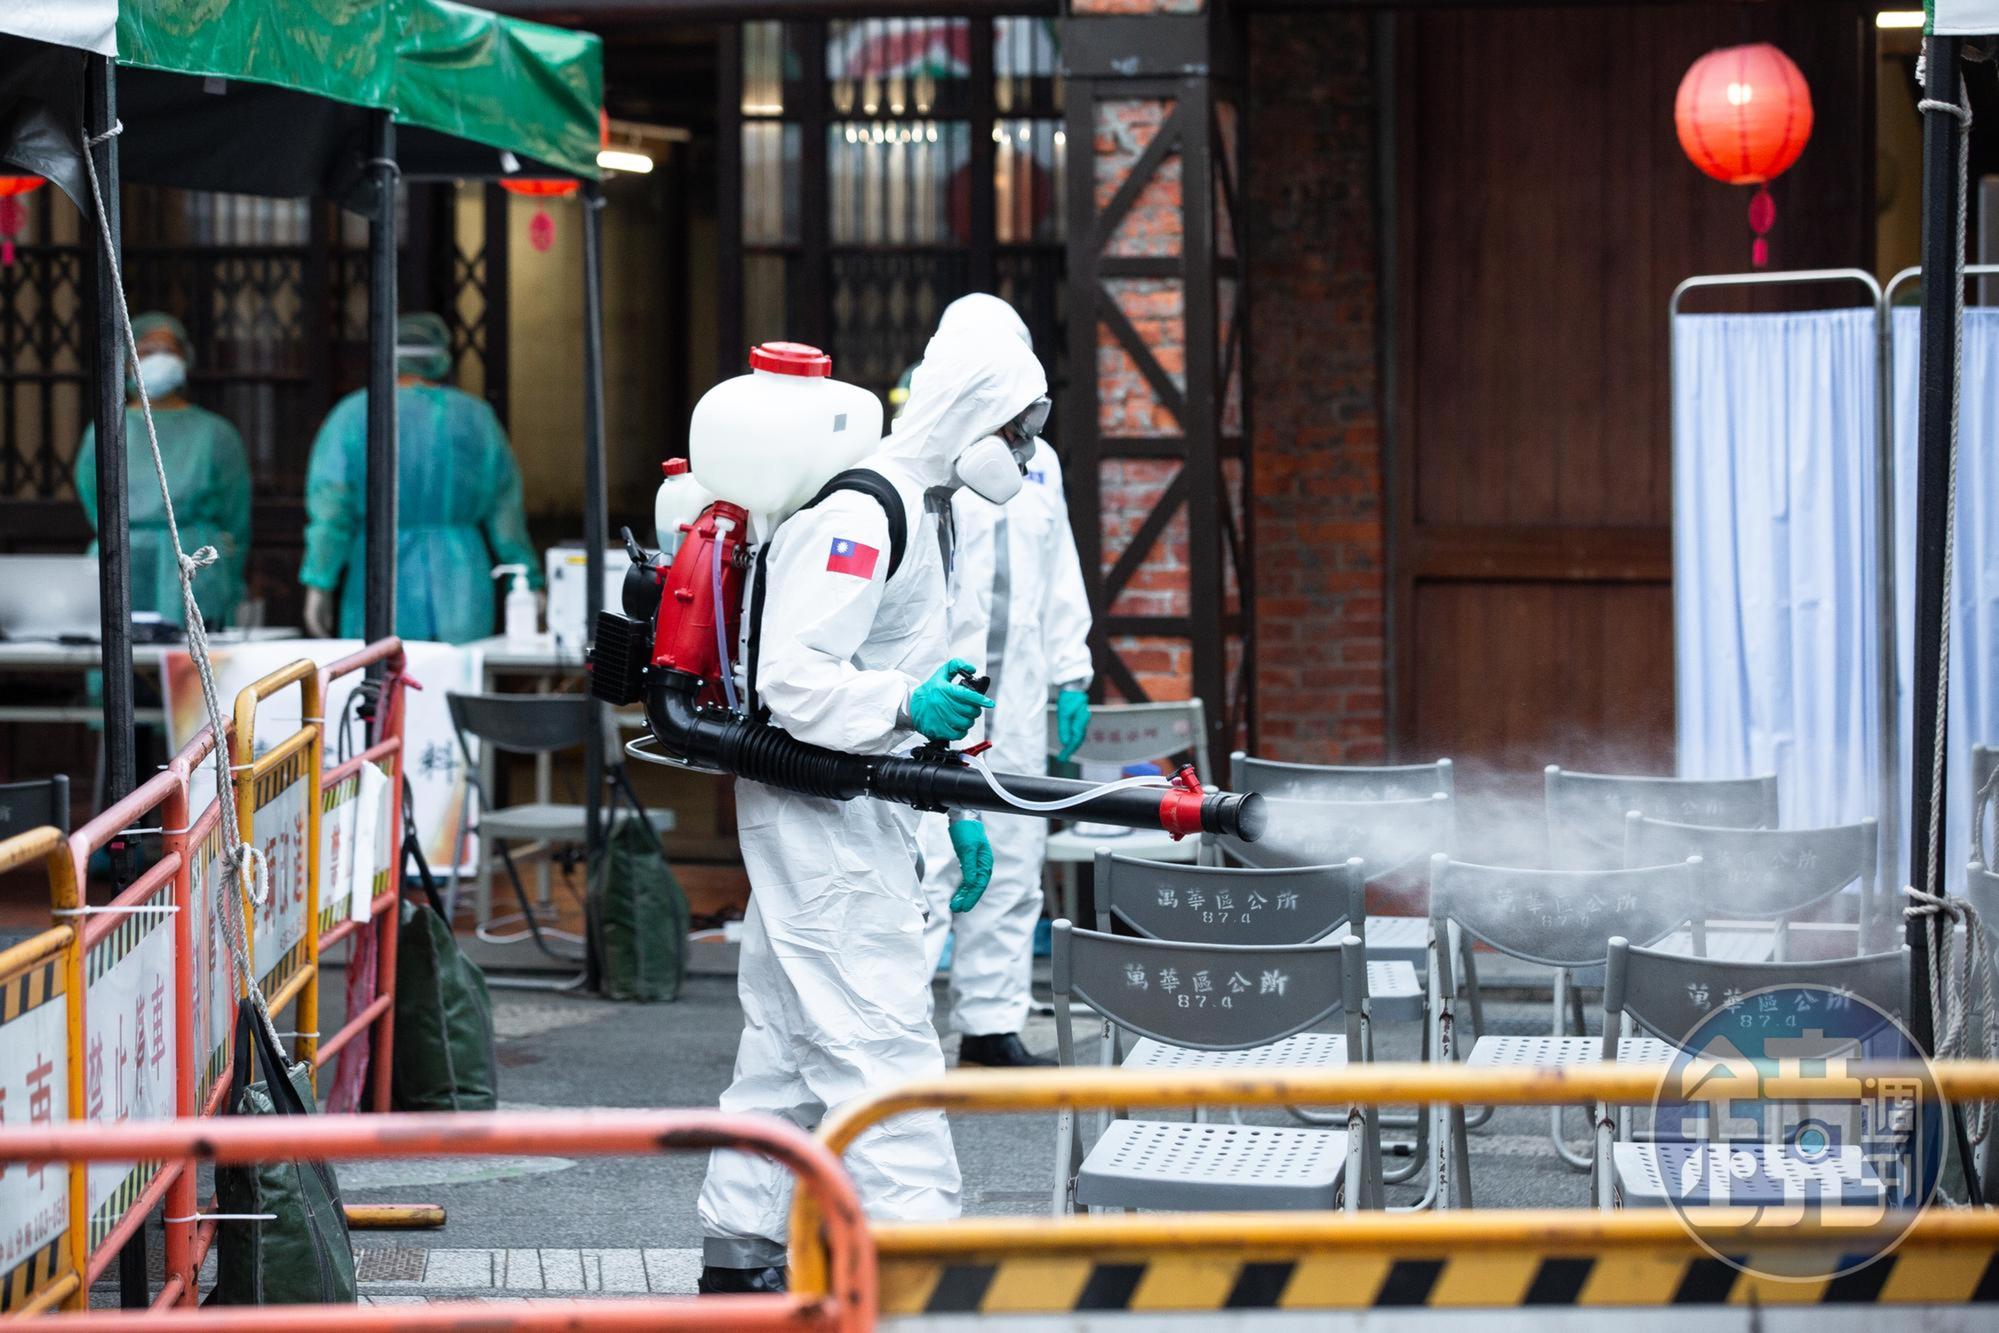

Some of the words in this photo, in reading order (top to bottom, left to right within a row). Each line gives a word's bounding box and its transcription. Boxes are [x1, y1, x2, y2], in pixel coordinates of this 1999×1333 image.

[1124, 963, 1288, 997] 萬華區公所
[1686, 982, 1856, 1016] 萬華區公所
